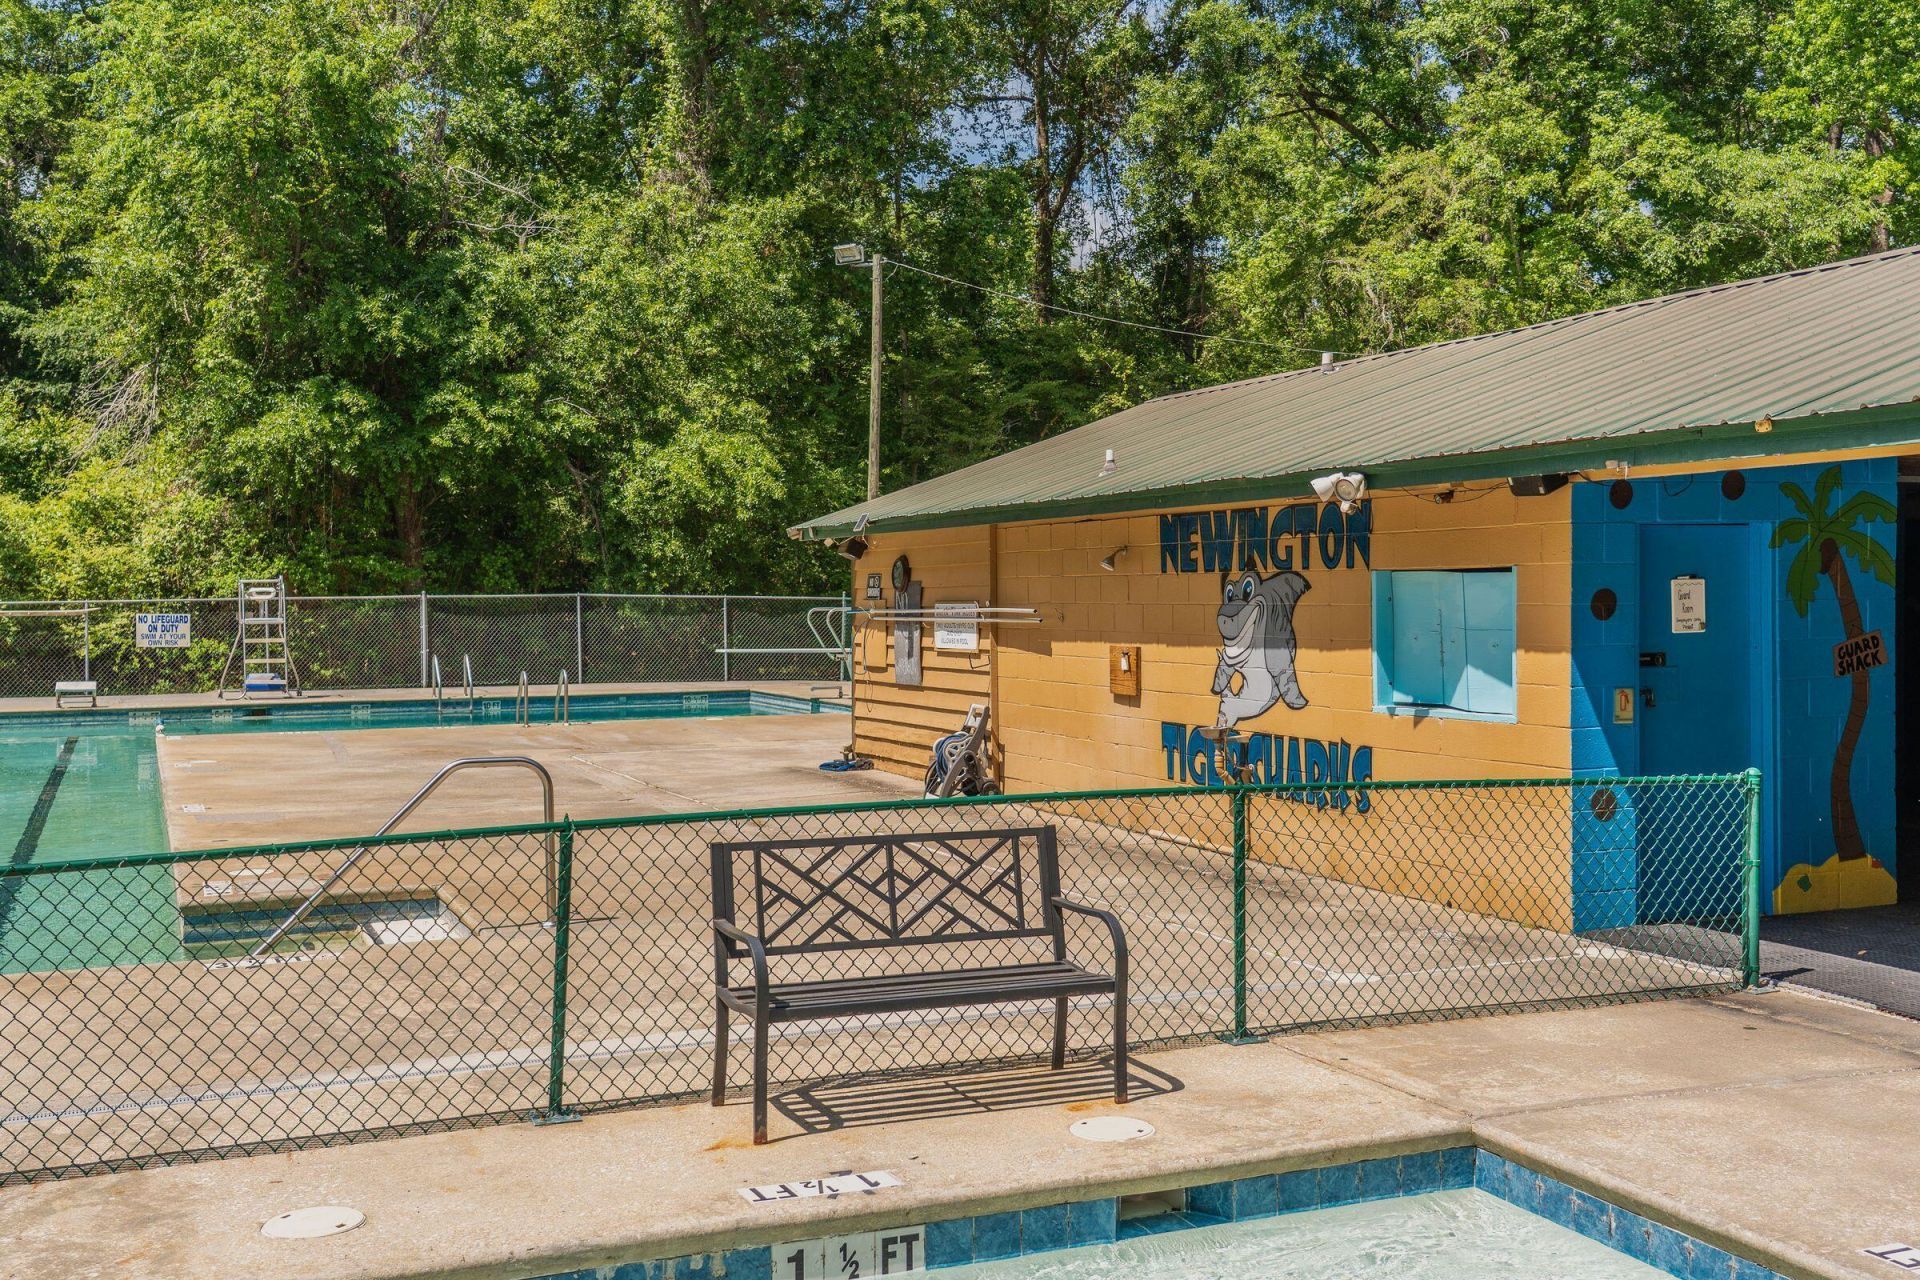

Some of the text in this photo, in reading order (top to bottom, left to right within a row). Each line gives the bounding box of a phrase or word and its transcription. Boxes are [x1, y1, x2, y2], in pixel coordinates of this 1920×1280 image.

[1160, 498, 1372, 575] NEWINGTON
[138, 615, 189, 624] NO LIFEGUARD
[147, 624, 179, 633] ON DUTY
[1838, 635, 1880, 660] GUARD
[1838, 650, 1882, 676] SHACK
[1247, 731, 1373, 816] SHARKS
[749, 1184, 799, 1202] FT
[855, 1174, 881, 1188] 1
[787, 1248, 805, 1280] 1
[881, 1233, 920, 1275] FT
